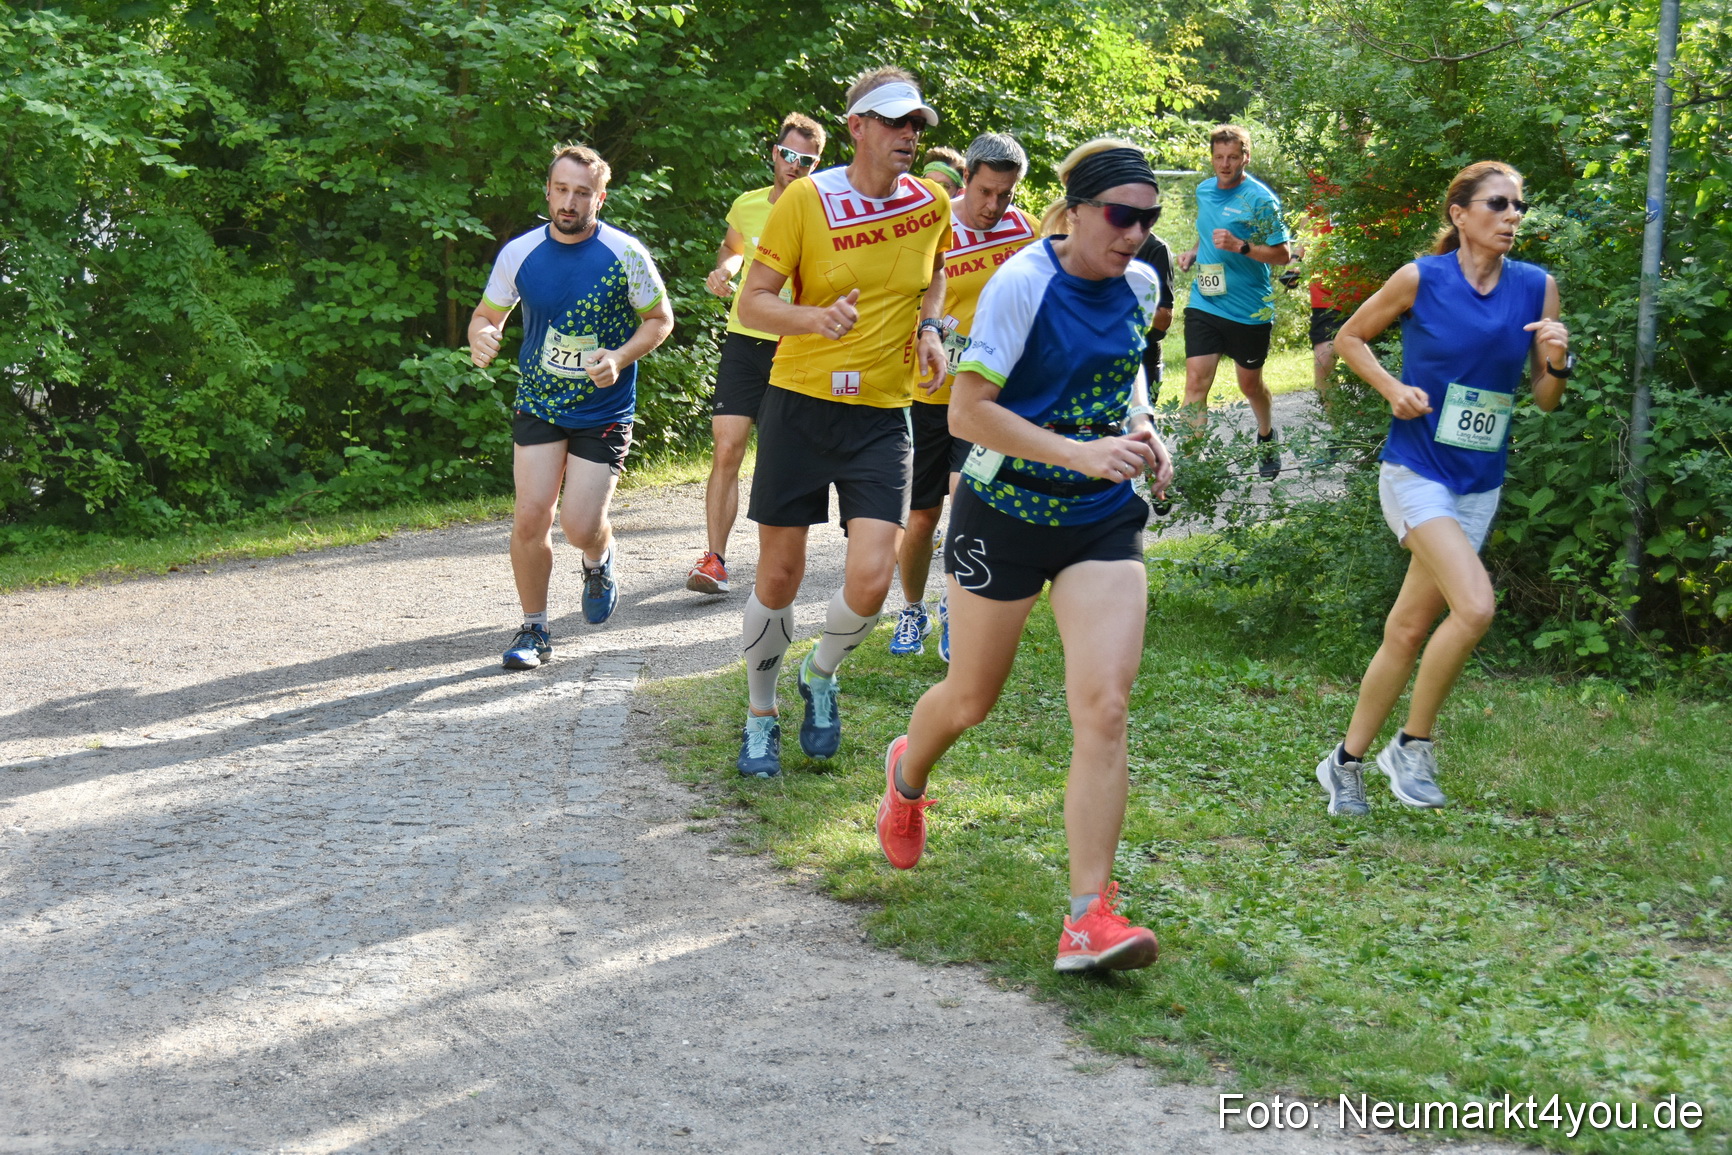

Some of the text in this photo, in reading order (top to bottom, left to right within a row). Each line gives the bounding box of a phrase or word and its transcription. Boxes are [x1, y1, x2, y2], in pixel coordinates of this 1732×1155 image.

[832, 210, 942, 252] MAX BÖGL
[944, 257, 987, 279] MAX
[550, 347, 582, 367] 271
[1458, 409, 1496, 435] 860
